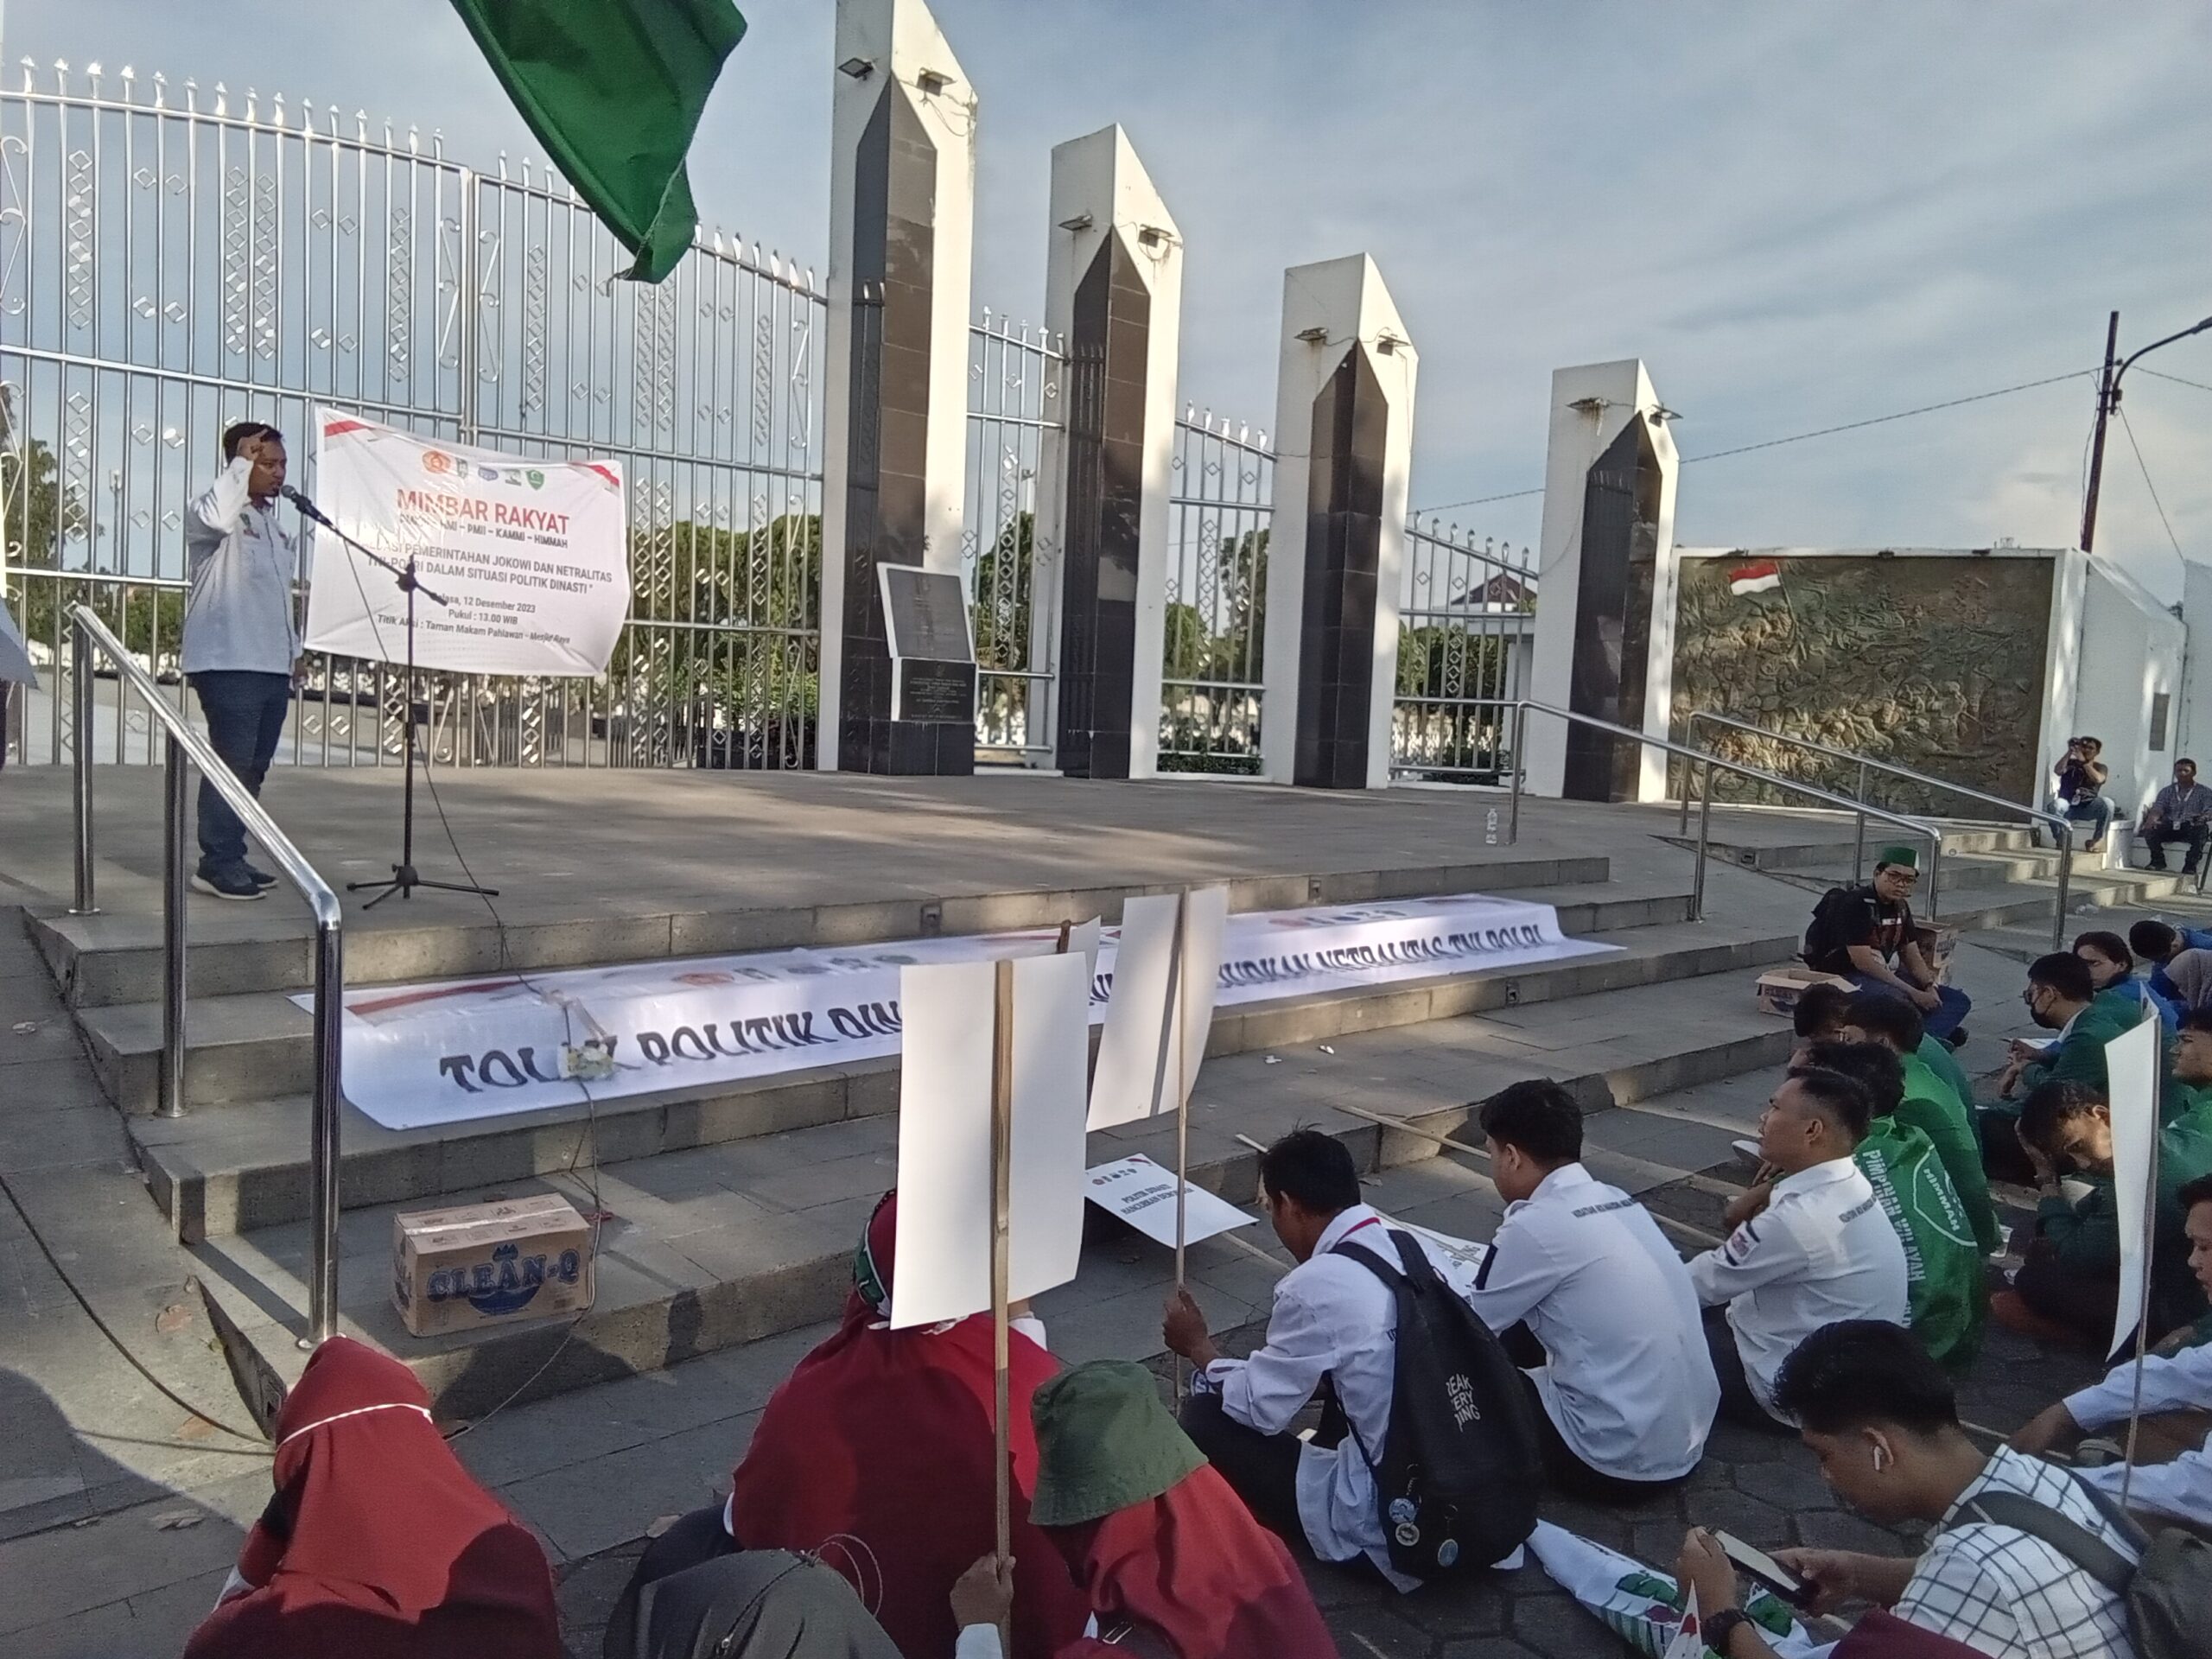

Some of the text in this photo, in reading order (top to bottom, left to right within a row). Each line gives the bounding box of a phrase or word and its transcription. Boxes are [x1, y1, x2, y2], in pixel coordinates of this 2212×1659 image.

[397, 489, 488, 521] MIMBAR
[495, 503, 569, 535] RAKYAT
[495, 529, 524, 541] KAMMI
[534, 535, 568, 548] HIMMAH
[405, 543, 490, 564] PEMERINTAHAN
[493, 556, 531, 571] JOKOWI
[533, 561, 554, 574] DAN
[556, 565, 612, 582] NETRALITAS
[426, 562, 464, 577] DALAM
[467, 568, 507, 582] SITUASI
[510, 573, 548, 588] POLITIK
[448, 609, 472, 620] Pukul
[479, 612, 501, 623] 13.00
[503, 615, 518, 625] WIB
[464, 596, 474, 606] 12
[475, 598, 515, 611] Desember
[517, 603, 536, 613] 2023
[378, 614, 397, 626] Titik
[426, 620, 454, 632] Taman
[455, 625, 486, 636] Makam
[487, 629, 523, 639] Pahlawan
[636, 1011, 839, 1065] POLITIK
[1923, 1167, 1961, 1231] HIMMAH
